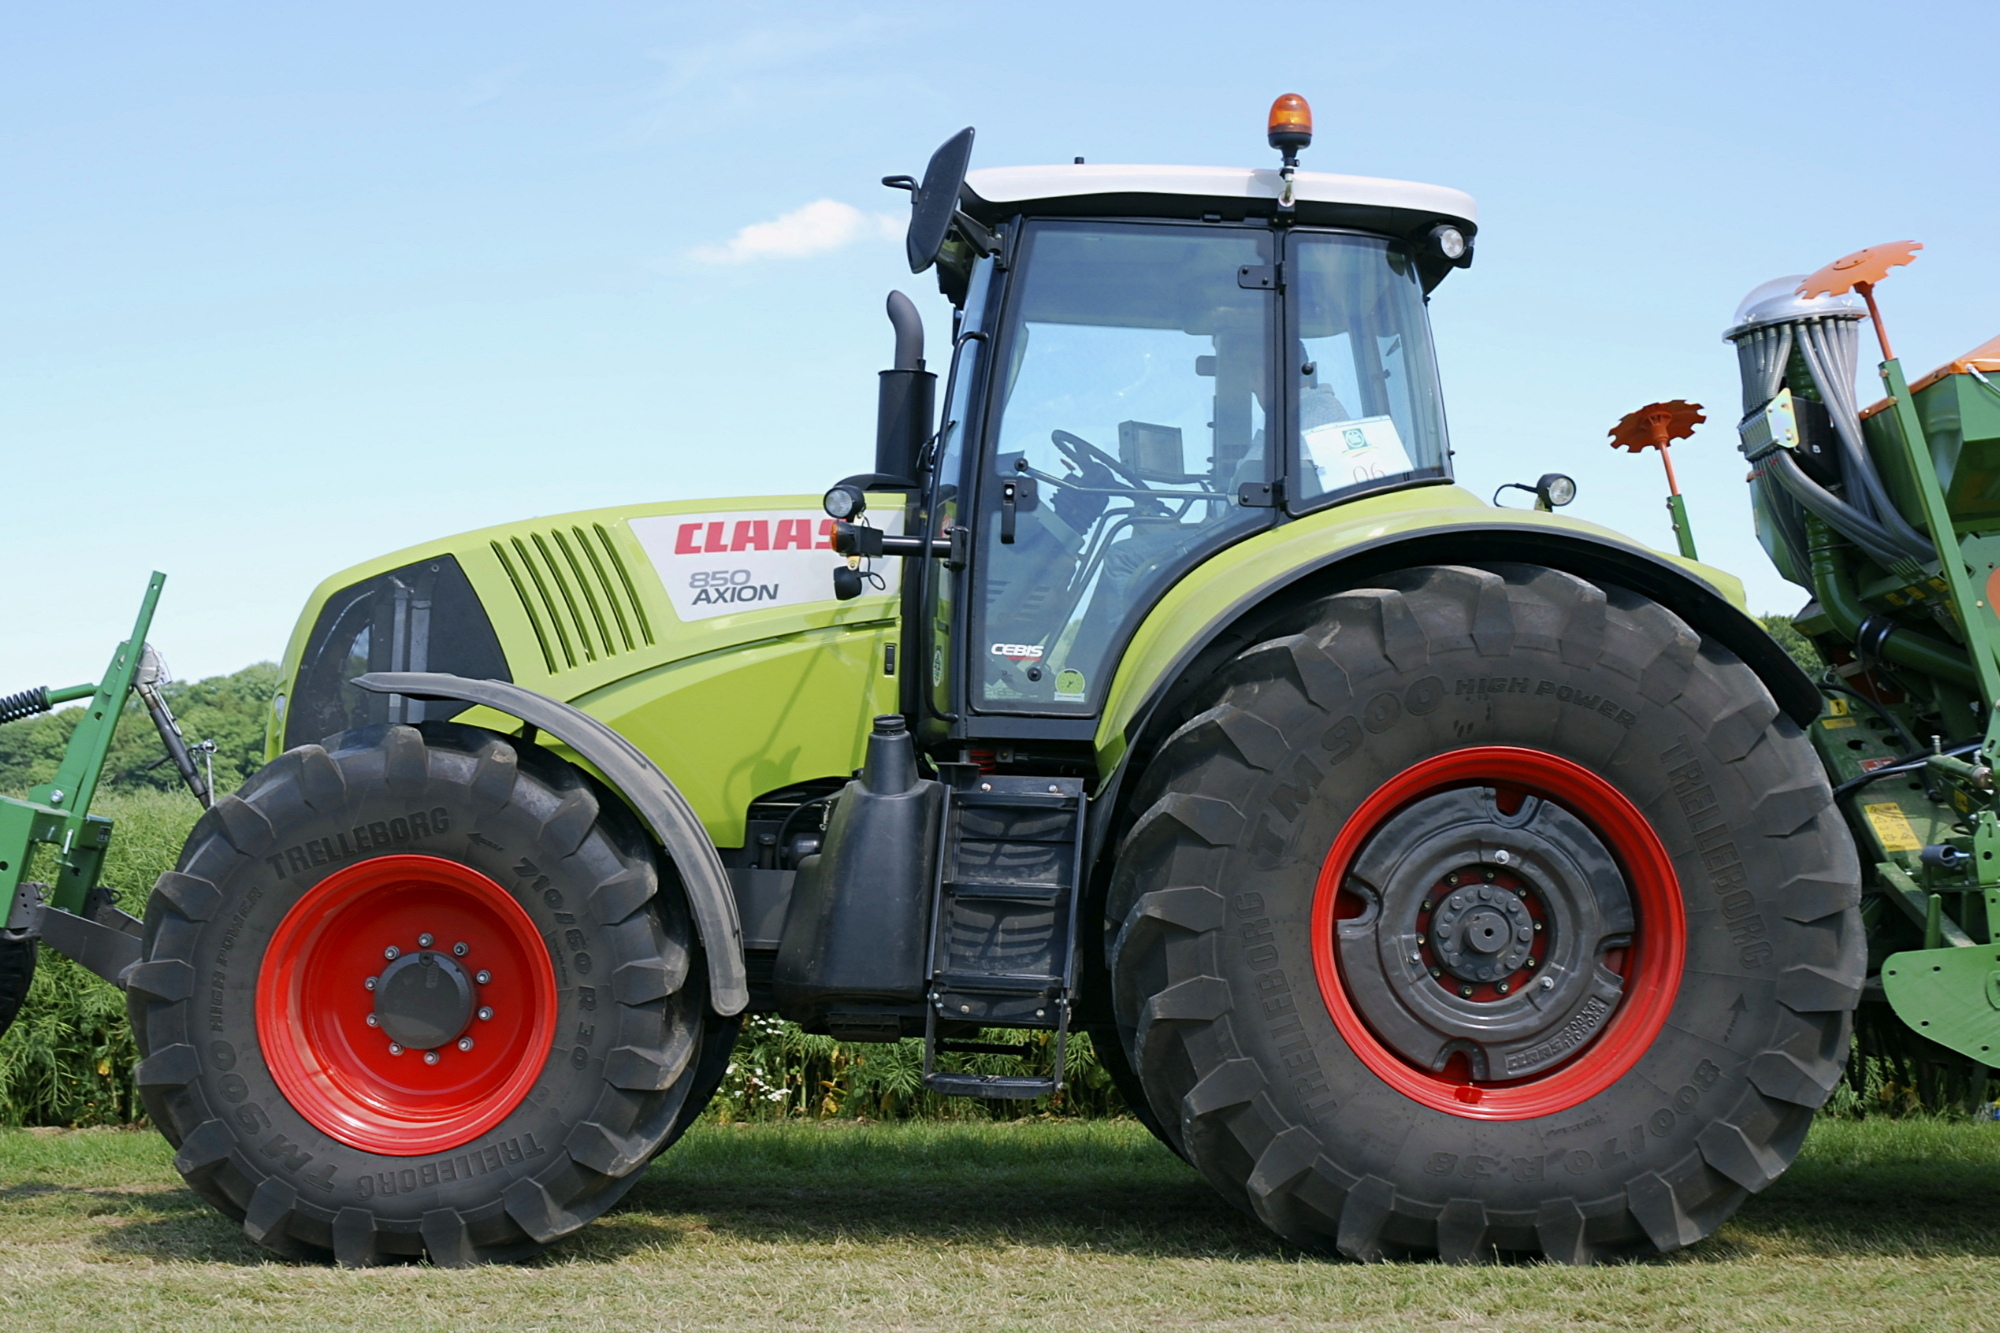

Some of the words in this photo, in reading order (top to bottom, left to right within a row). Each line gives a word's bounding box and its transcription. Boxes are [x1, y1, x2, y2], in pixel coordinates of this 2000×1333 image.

[688, 569, 751, 589] 850
[691, 583, 779, 606] AXION
[990, 643, 1045, 657] CEBIS
[1454, 677, 1530, 696] HIGH
[1534, 679, 1638, 730] POWER
[266, 806, 450, 880] TRELLEBORG
[1660, 733, 1774, 970] TRELLEBORG
[215, 886, 264, 968] POWER
[209, 970, 226, 1033] HIGH
[1233, 891, 1338, 1127] TRELLEBORG
[355, 1132, 546, 1201] TRELLEBORG
